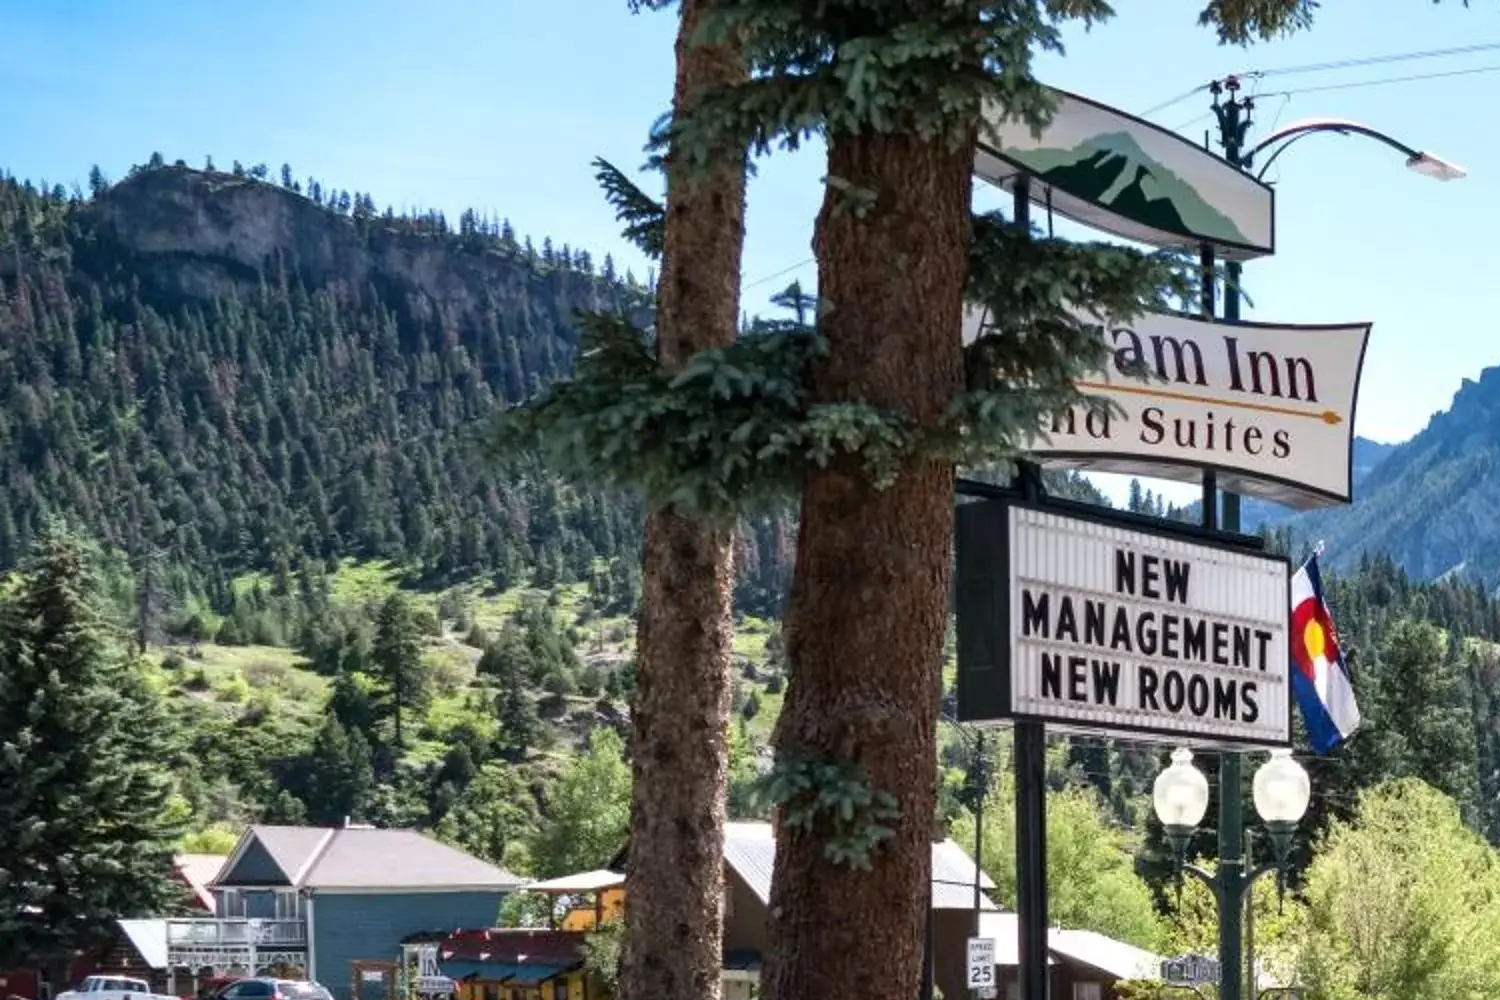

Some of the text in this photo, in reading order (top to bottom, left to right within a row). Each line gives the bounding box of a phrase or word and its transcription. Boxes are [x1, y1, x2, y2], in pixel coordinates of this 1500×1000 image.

[1222, 335, 1318, 402] Inn
[1139, 406, 1292, 458] Suites
[1116, 549, 1190, 604] NEW
[1022, 588, 1272, 671] MANAGEMENT
[1041, 652, 1259, 723] NEW ROOMS
[971, 965, 992, 983] 25
